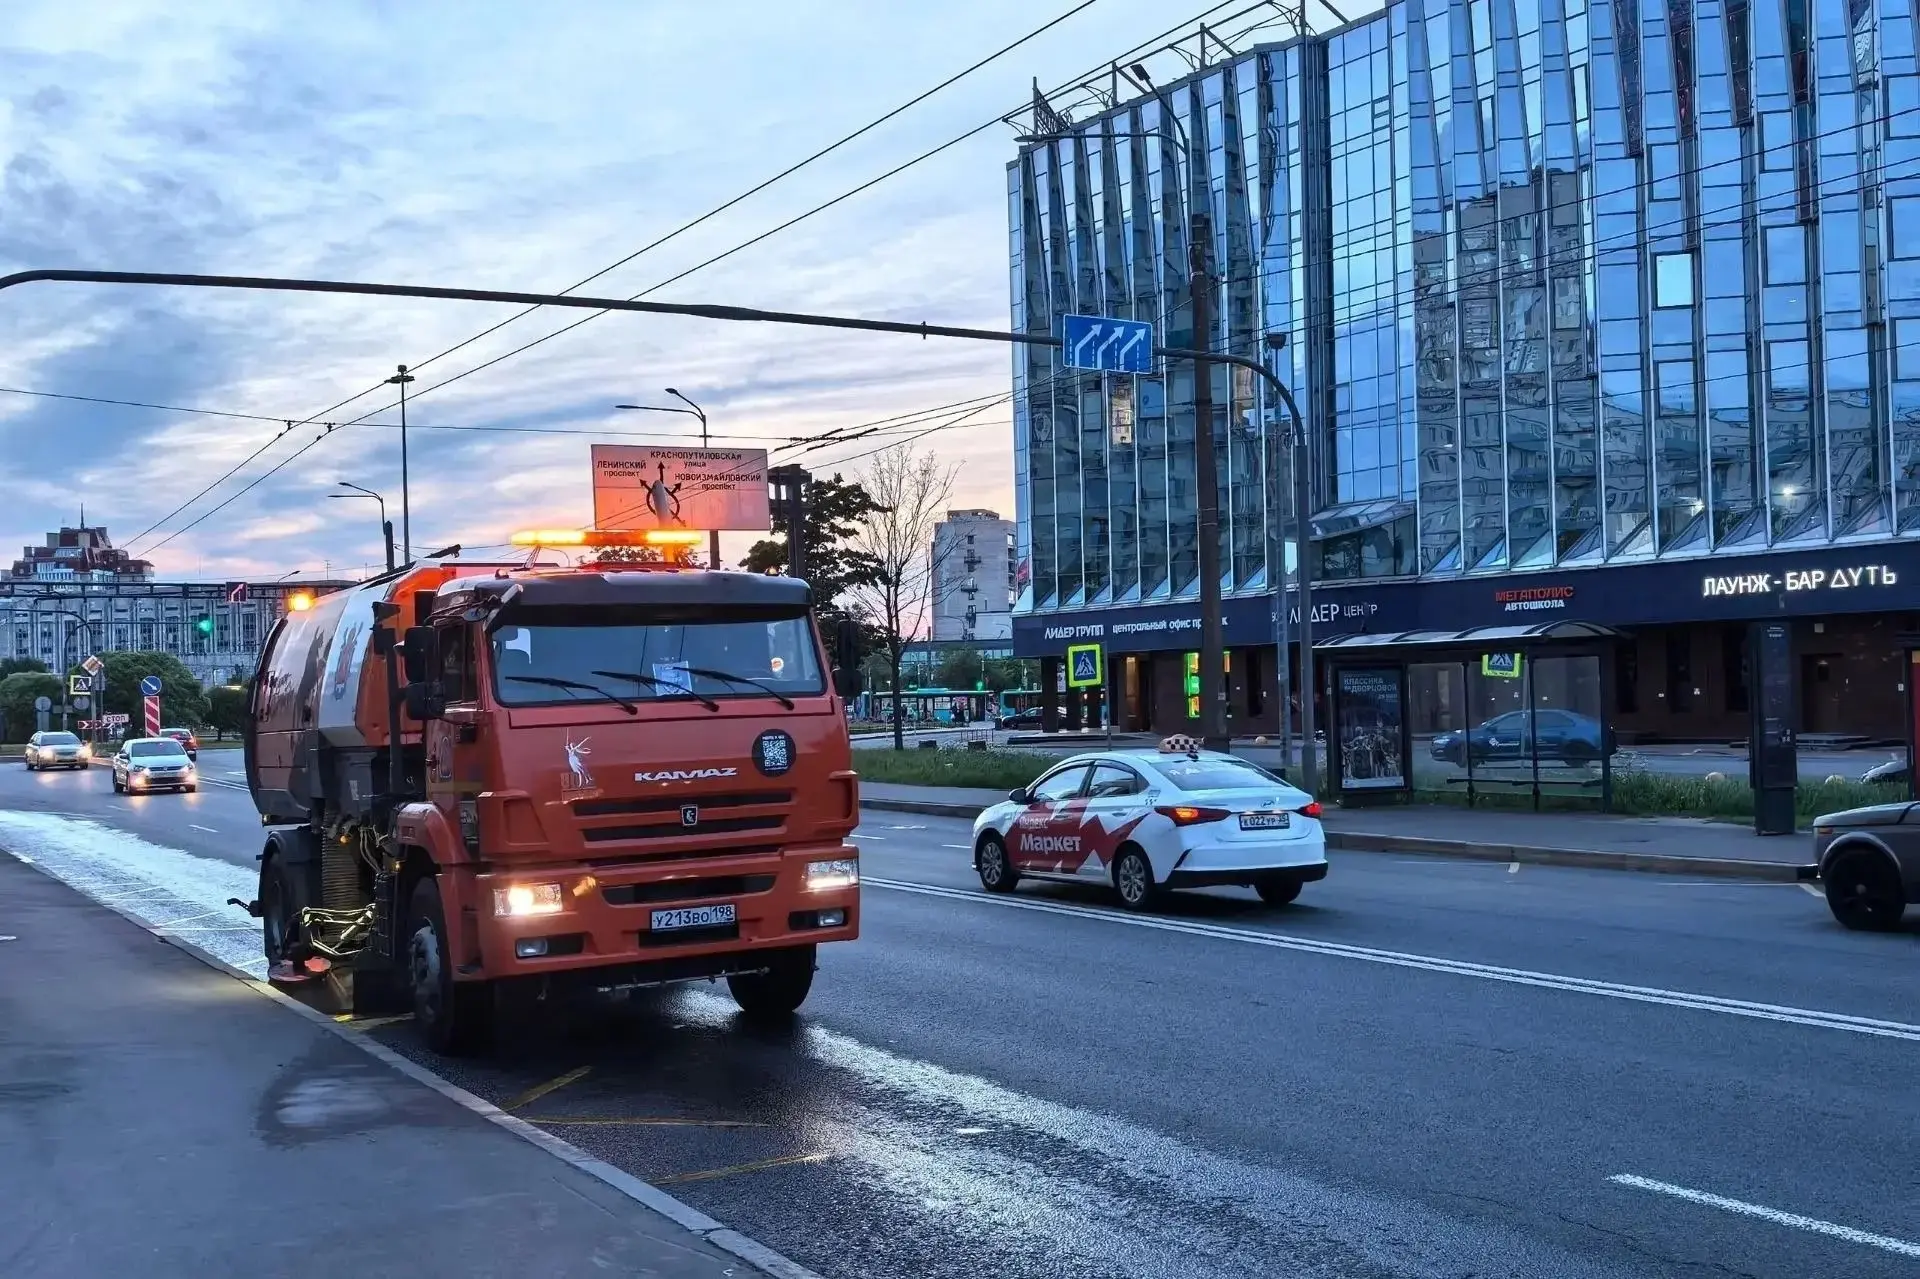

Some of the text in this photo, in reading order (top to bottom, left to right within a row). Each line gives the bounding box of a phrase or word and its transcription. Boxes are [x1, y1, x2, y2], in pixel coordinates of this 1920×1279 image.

[650, 451, 742, 460] КРАСНОПУТИЛОВСКАЯ
[597, 460, 647, 469] ЛЕНИНСКИЙ
[683, 461, 707, 469] улица
[604, 470, 640, 478] проспект
[674, 472, 761, 482] НОВОИЗМАЙЛОВСКИЙ
[701, 483, 736, 491] проспект
[1495, 586, 1574, 602] МЕГАПОЛИС
[1343, 604, 1378, 618] ЦЕНР
[1504, 599, 1565, 612] АВТОШКОЛА
[1045, 626, 1075, 640] ЛИДЕР
[1076, 624, 1104, 638] ГРУПП
[1112, 619, 1167, 635] центральный
[1168, 617, 1191, 632] офис
[634, 767, 738, 782] KAMAZ
[1020, 833, 1082, 855] Маркет
[711, 905, 732, 918] 198
